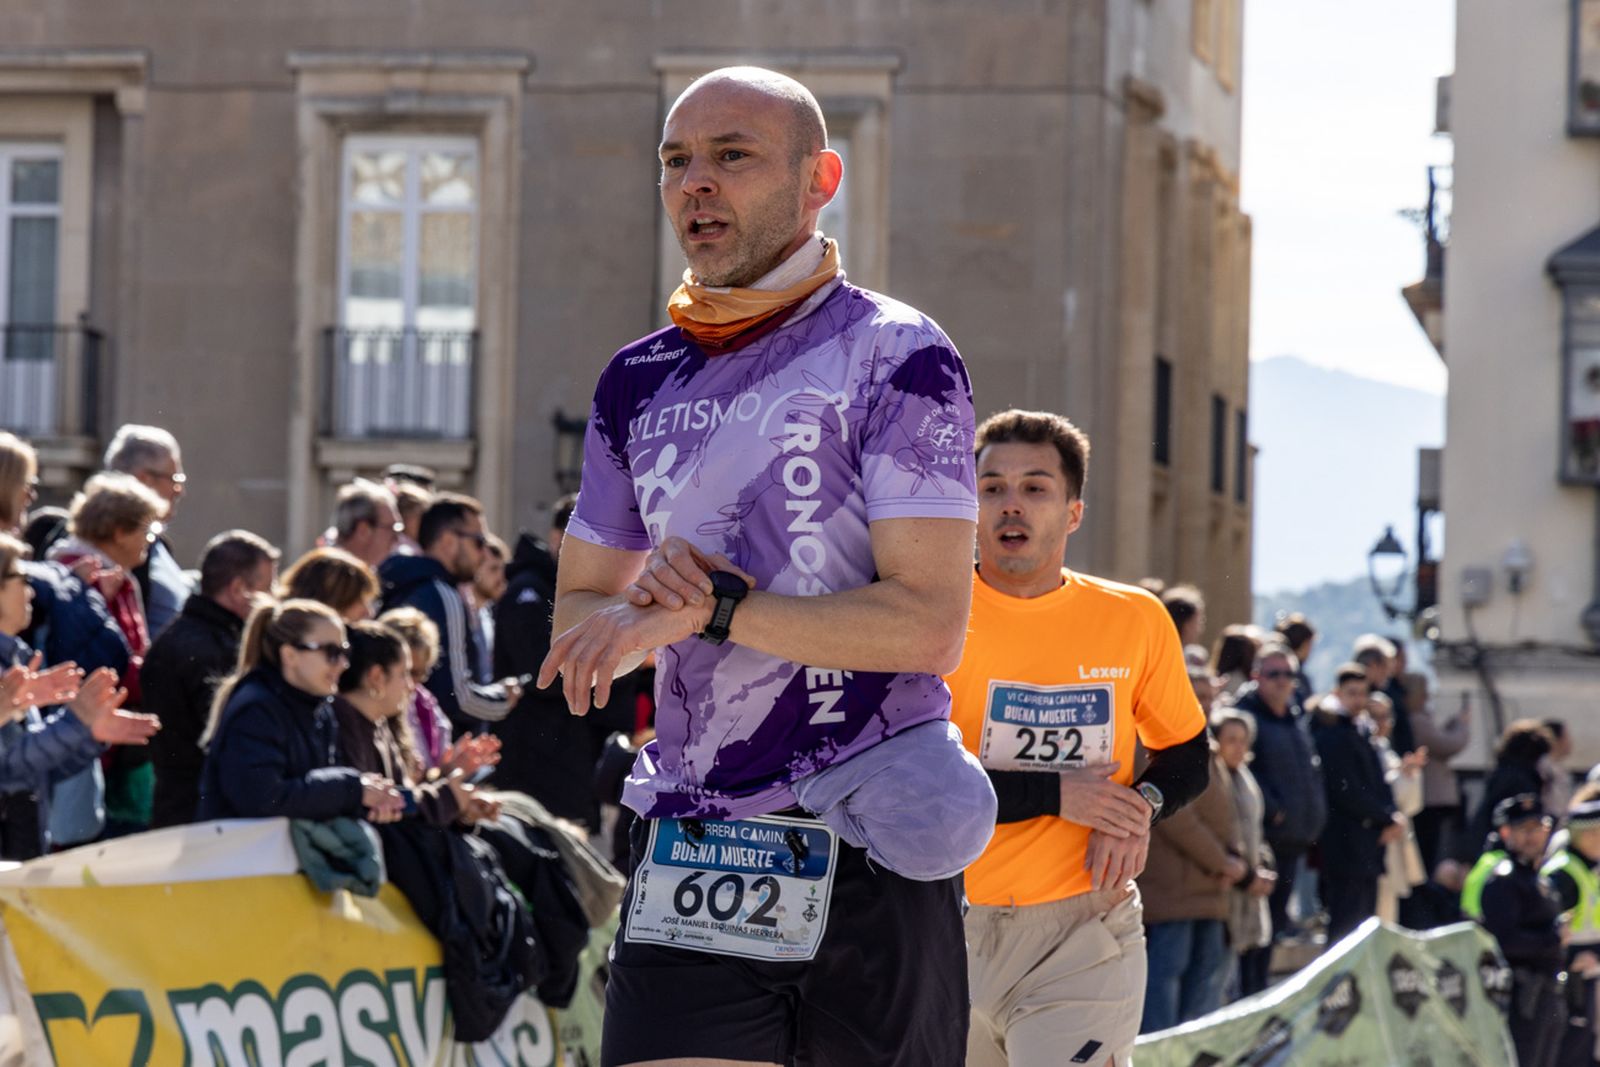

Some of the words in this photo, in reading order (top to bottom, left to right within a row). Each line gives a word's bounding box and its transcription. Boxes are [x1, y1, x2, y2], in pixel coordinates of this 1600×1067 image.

[624, 346, 688, 366] TEAMERGY
[931, 454, 966, 465] Jaén
[804, 664, 853, 725] ÉN
[1055, 693, 1097, 704] CAMINATA
[1004, 705, 1036, 723] BUENA
[1038, 708, 1077, 724] MUERTE
[1014, 727, 1084, 762] 252
[670, 841, 716, 865] BUENA
[719, 845, 776, 868] MUERTE
[673, 870, 782, 928] 602
[661, 916, 680, 926] JOSÉ
[681, 918, 710, 930] MANUEL
[710, 921, 749, 936] ESQUINAS
[749, 928, 785, 941] HERRERA
